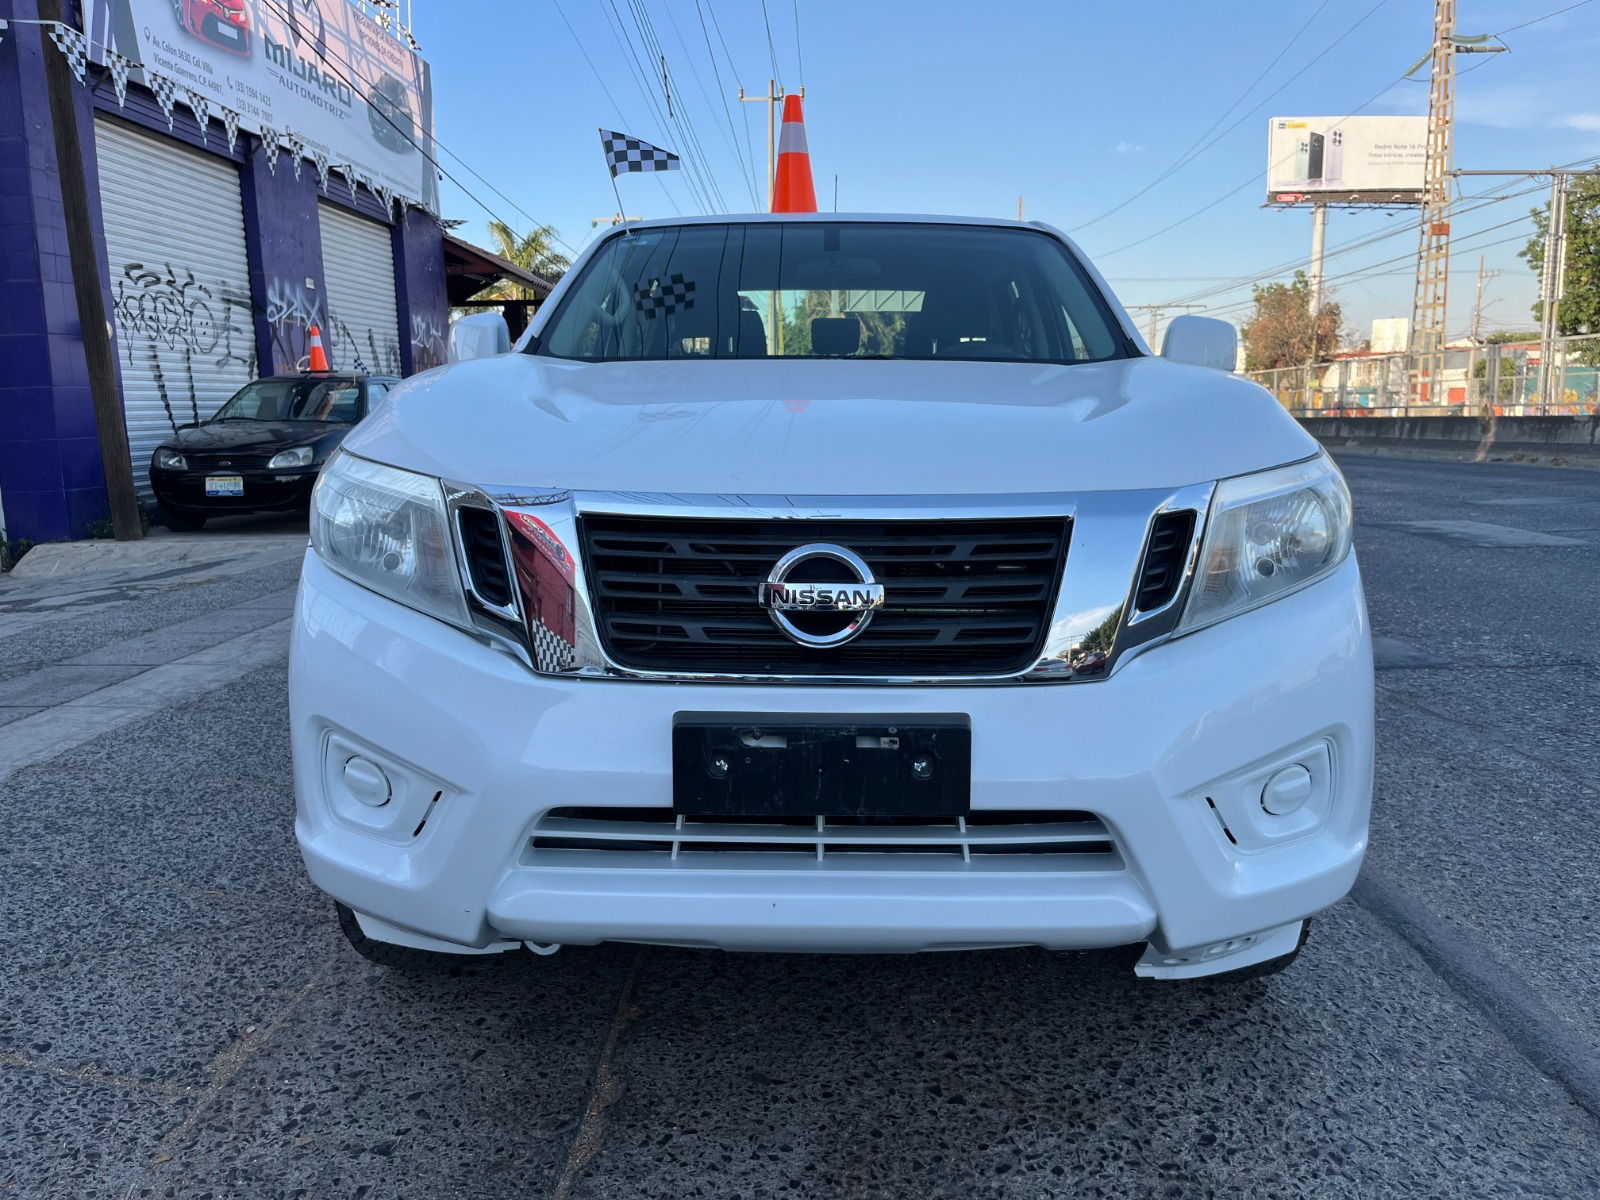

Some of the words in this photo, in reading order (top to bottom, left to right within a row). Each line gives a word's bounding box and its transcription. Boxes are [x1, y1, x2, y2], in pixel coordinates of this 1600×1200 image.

[152, 35, 162, 50] Av.
[161, 40, 177, 56] Colon
[177, 48, 192, 64] 3630,
[192, 56, 202, 71] Col.
[201, 59, 214, 75] Villa
[153, 52, 174, 72] Vicente
[173, 63, 199, 86] Guerrero,
[198, 76, 208, 90] C.P.
[207, 80, 224, 97] 44987,
[235, 79, 246, 95] (33)
[245, 85, 258, 99] 1594
[259, 91, 272, 107] 1423
[236, 96, 247, 113] (33)
[246, 102, 260, 117] 3144
[262, 110, 274, 124] 7007
[278, 75, 345, 119] AUTOMOTRIZ
[771, 589, 871, 605] NISSAN
